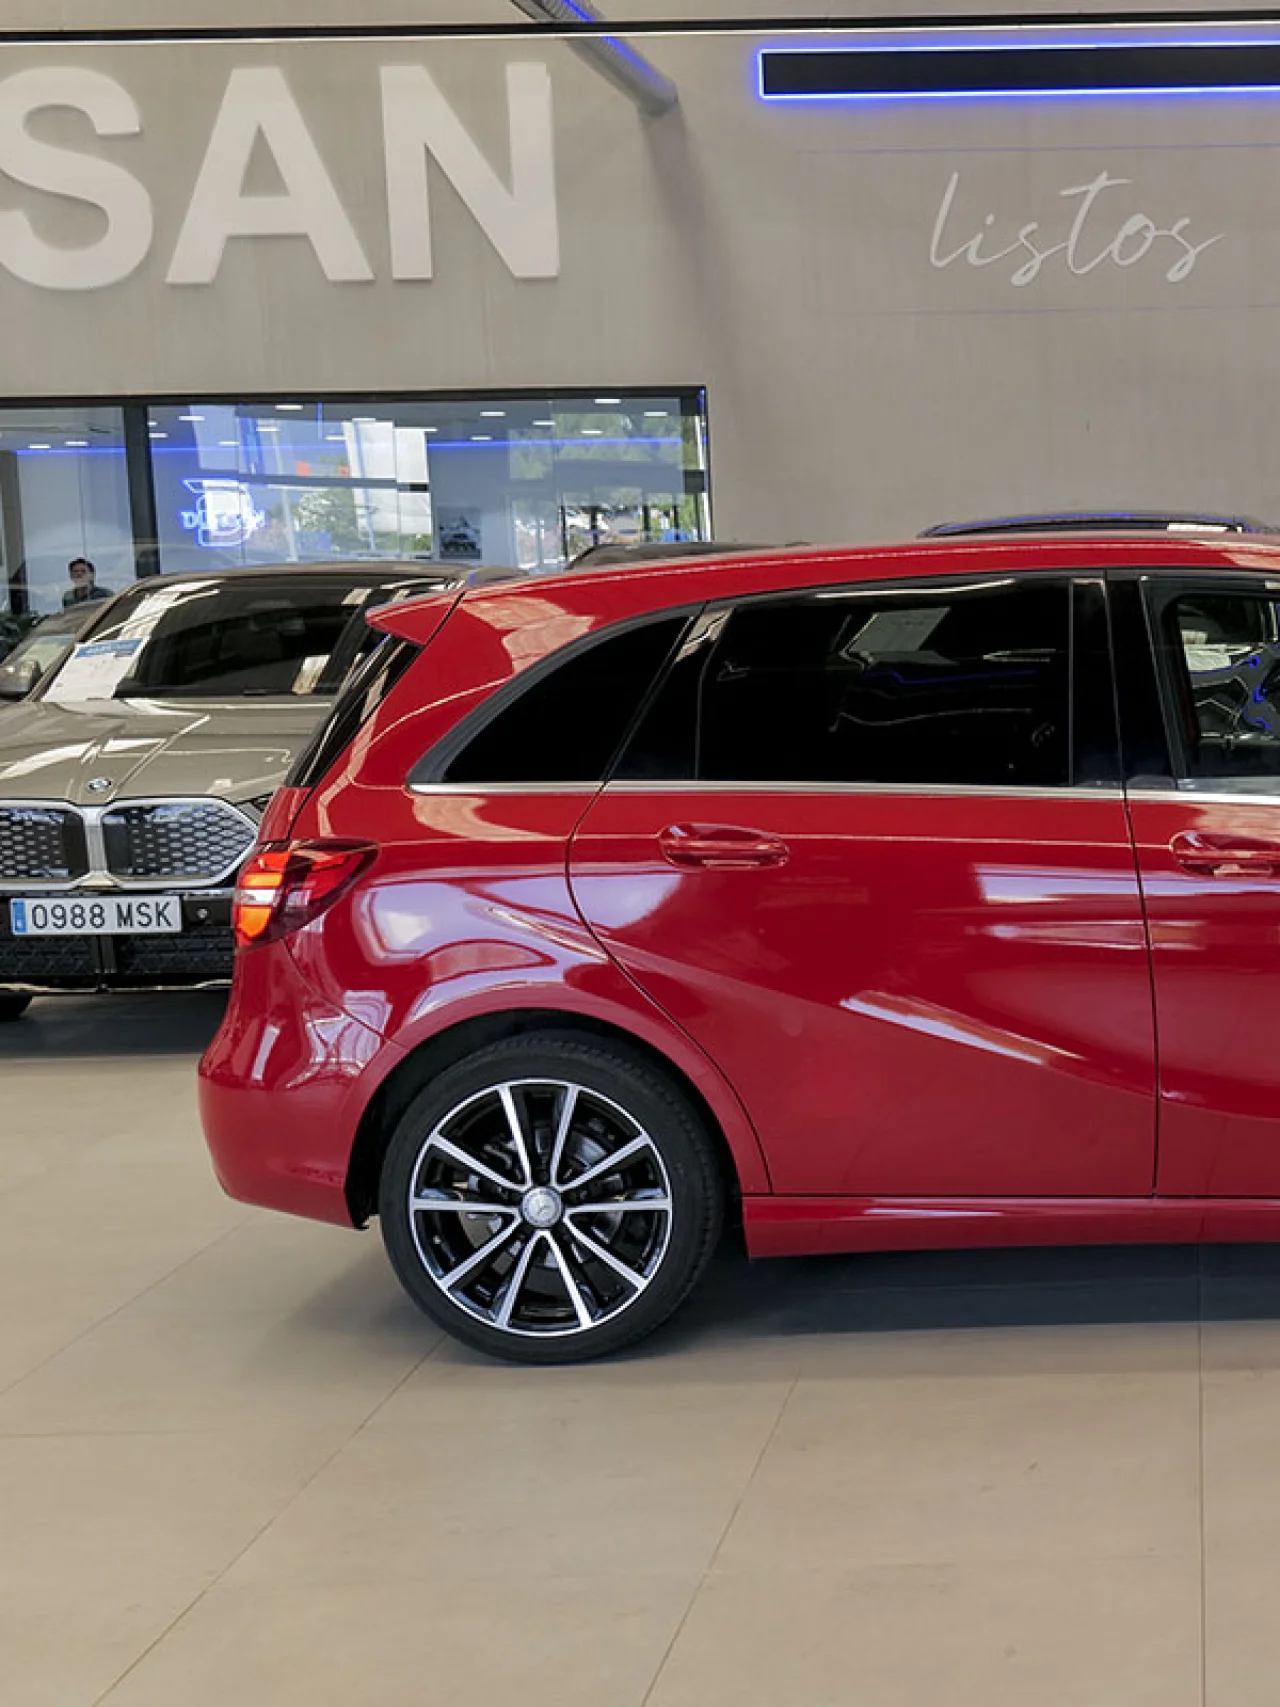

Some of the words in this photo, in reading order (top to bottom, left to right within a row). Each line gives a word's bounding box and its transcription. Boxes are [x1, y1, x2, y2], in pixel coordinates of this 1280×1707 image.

[0, 62, 560, 290] SAN
[930, 171, 1225, 286] listos
[31, 904, 106, 929] 0988
[116, 902, 172, 927] MSK
